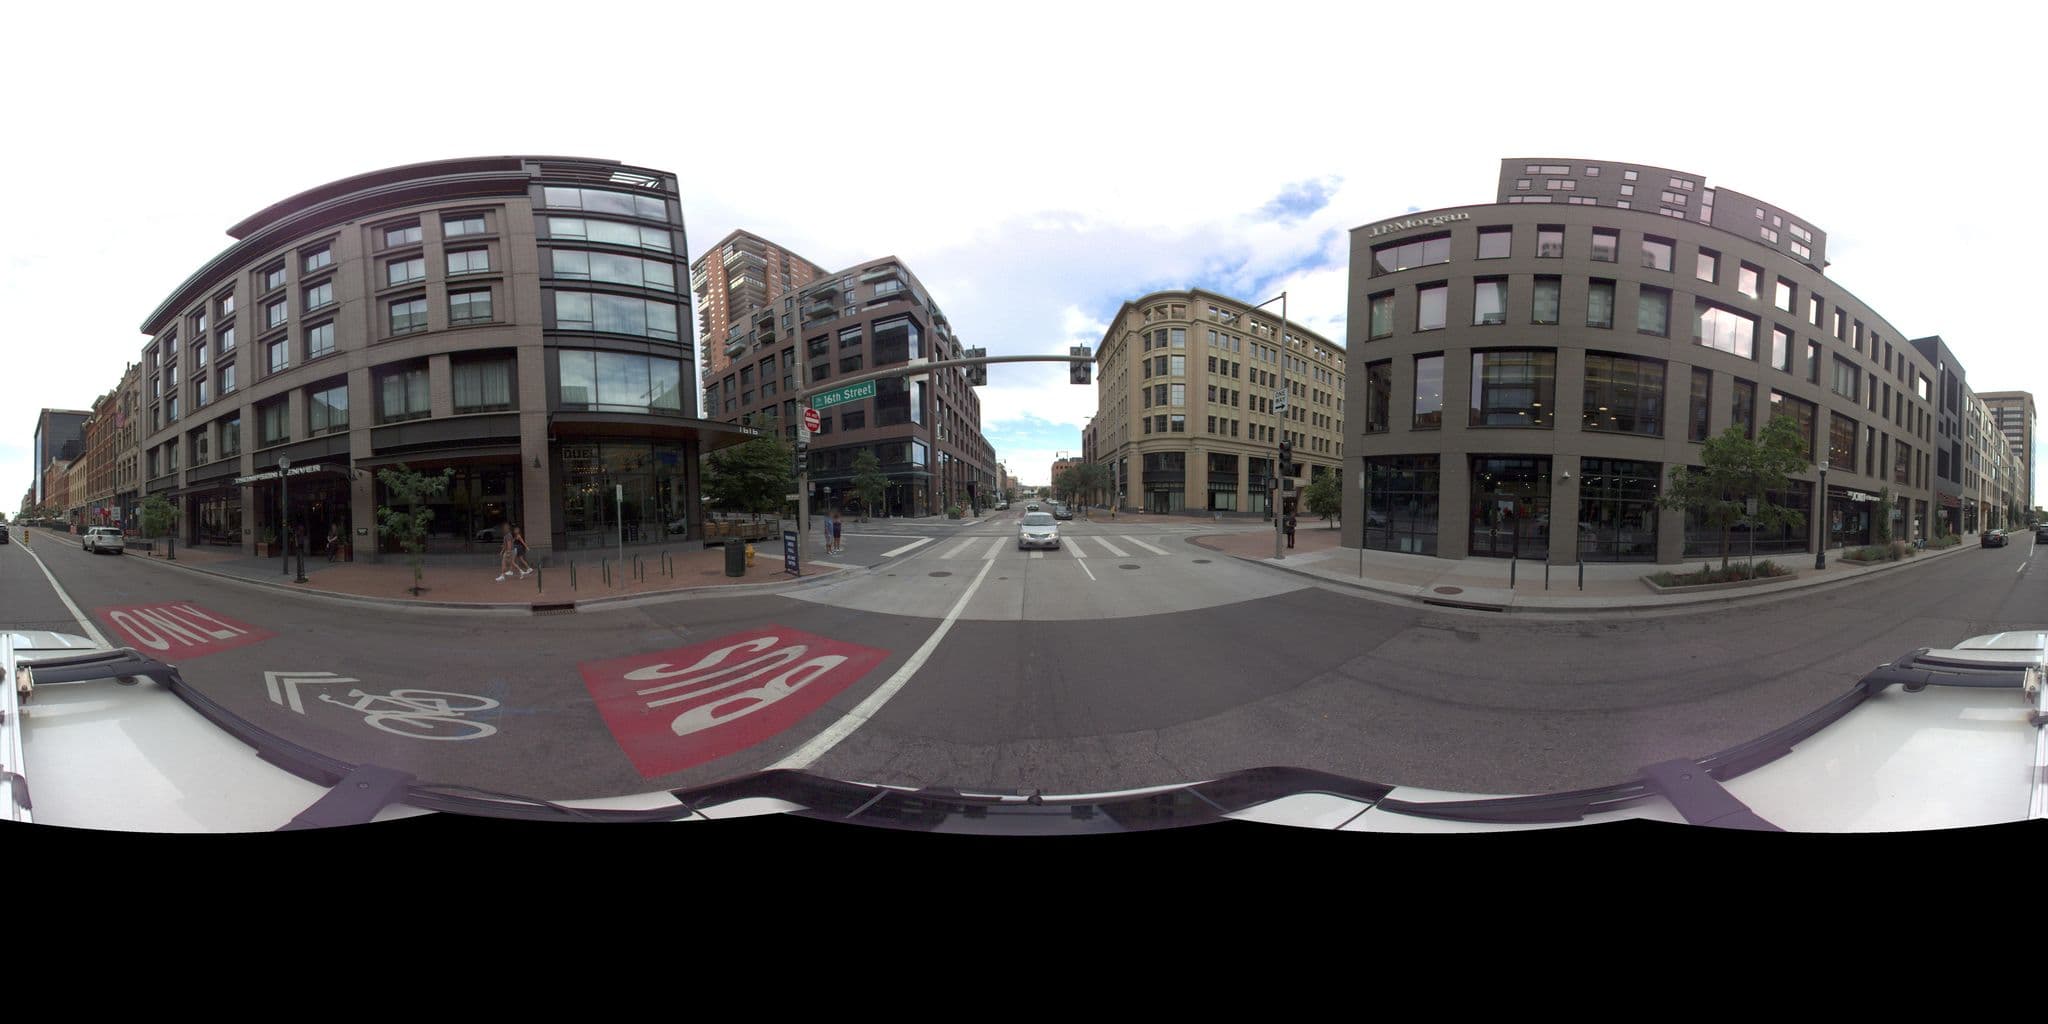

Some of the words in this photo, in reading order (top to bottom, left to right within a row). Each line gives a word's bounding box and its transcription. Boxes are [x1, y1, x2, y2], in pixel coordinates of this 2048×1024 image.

[823, 392, 841, 405] 16th
[843, 384, 872, 399] Street
[109, 604, 249, 651] ONLY
[623, 636, 849, 737] BUS
